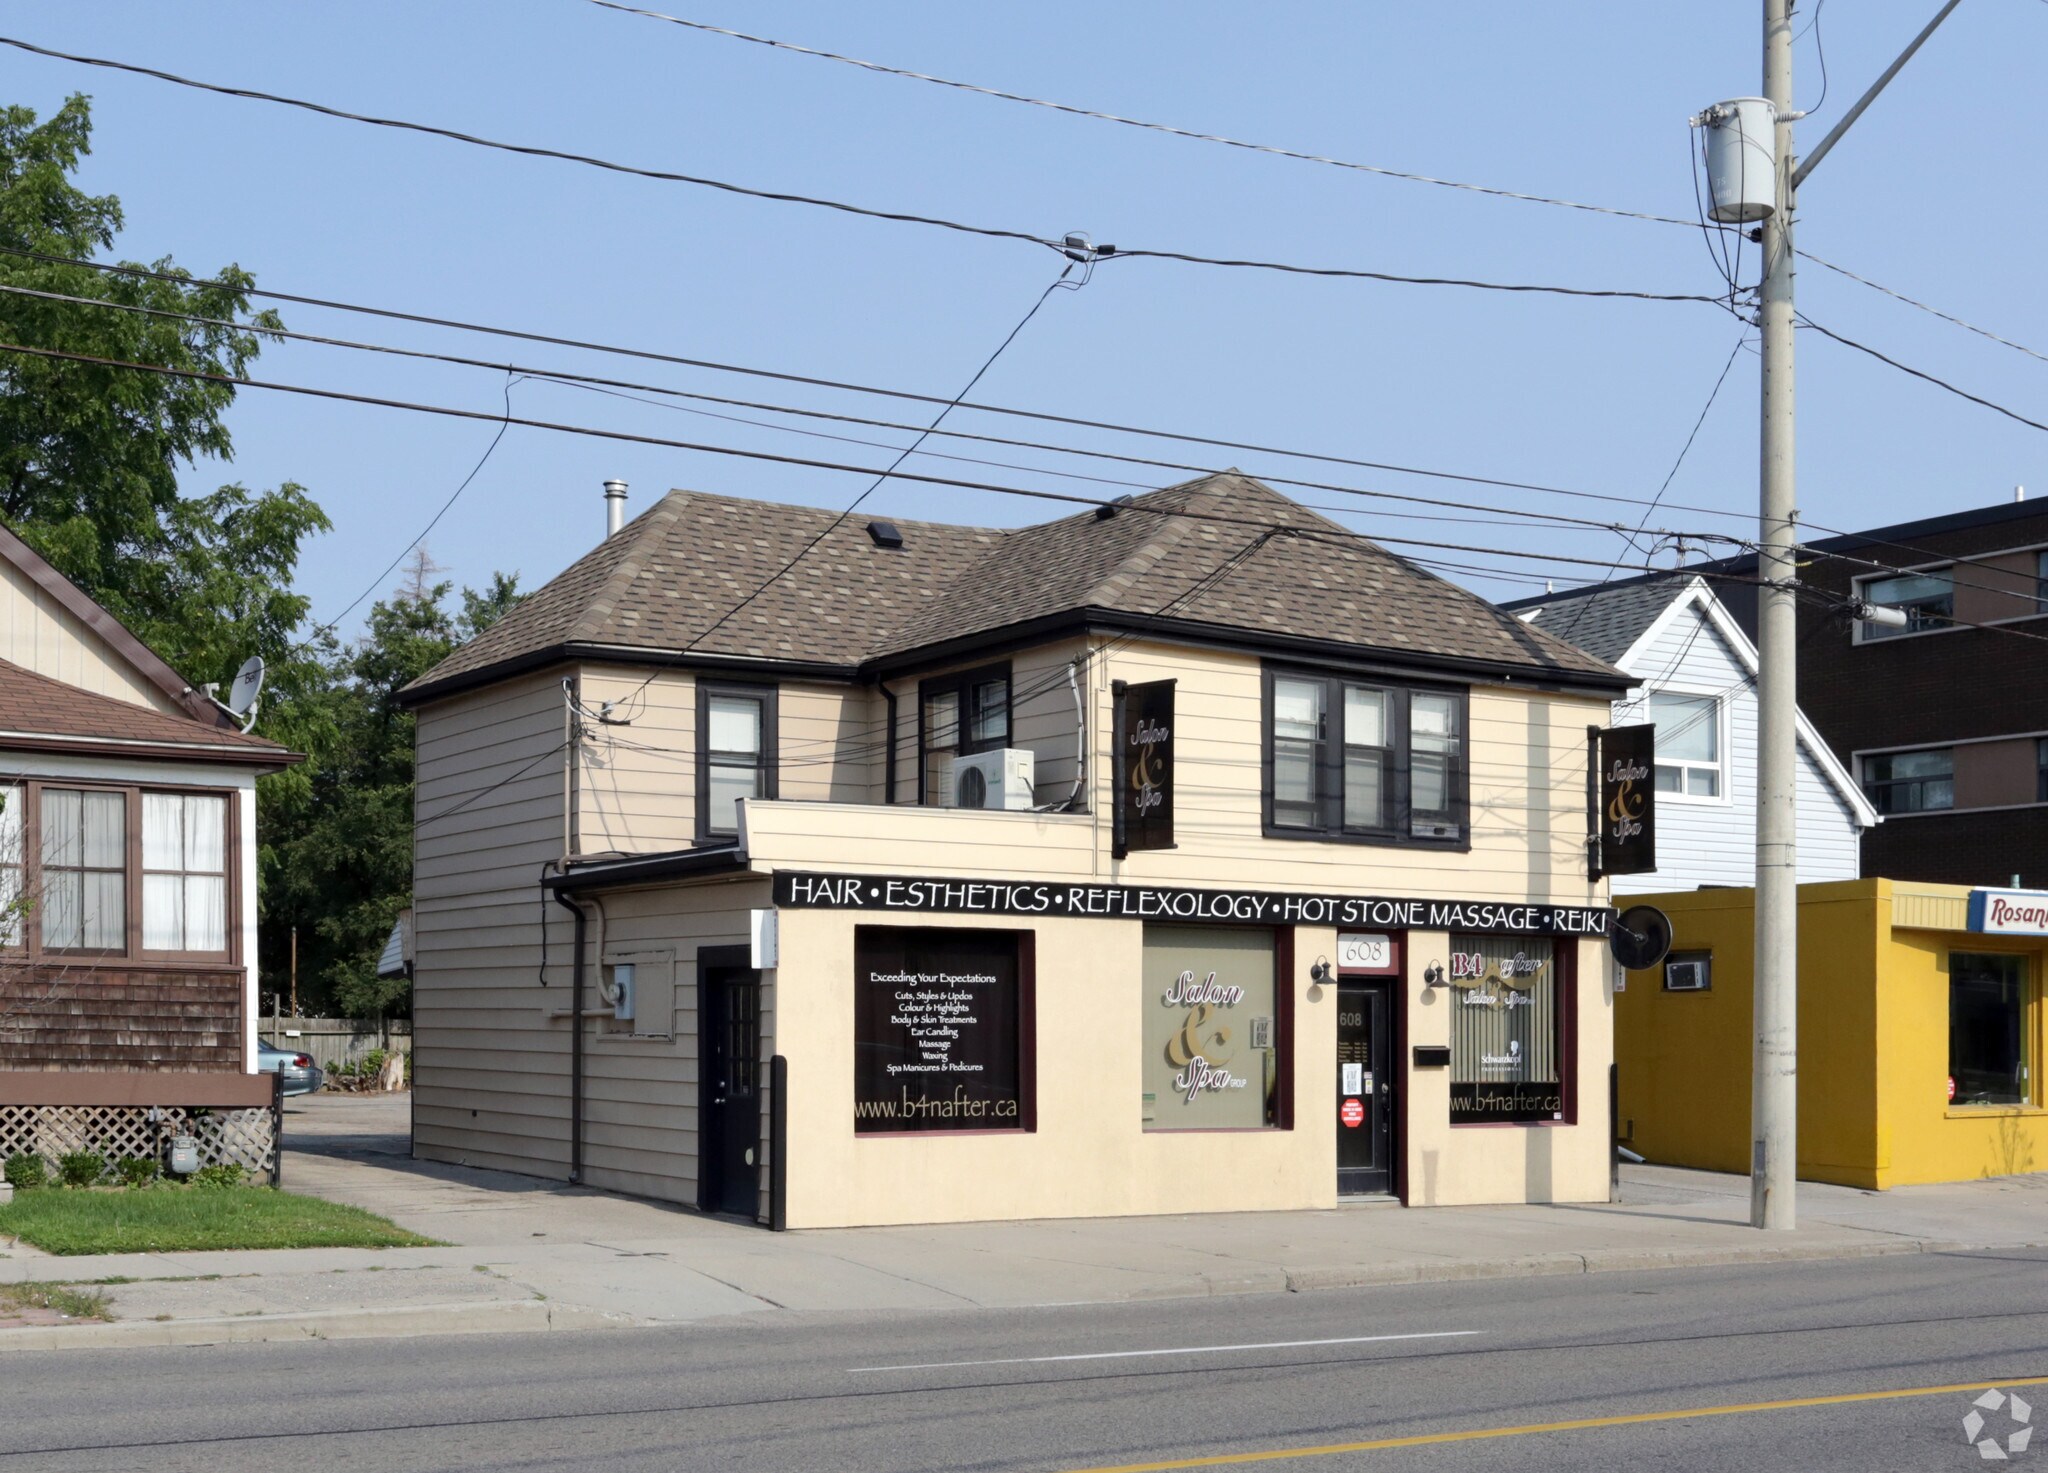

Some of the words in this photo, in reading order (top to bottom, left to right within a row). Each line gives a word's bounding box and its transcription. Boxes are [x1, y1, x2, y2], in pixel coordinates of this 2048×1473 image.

[1130, 718, 1169, 746] Salon
[1132, 742, 1167, 790] &
[1607, 759, 1649, 782] Salon
[1135, 782, 1162, 817] Spa
[1609, 780, 1646, 822] &
[1613, 815, 1642, 845] Spa
[791, 877, 864, 905] HAIR
[885, 880, 1049, 911] ESTHETICS
[1067, 887, 1269, 919] REFLEXOLOGY
[1284, 898, 1341, 922] HOT
[1341, 899, 1425, 925] STONE
[1429, 903, 1540, 930] MASSAGE
[1553, 909, 1607, 933] REIKI
[1991, 898, 2048, 929] Rosan
[1346, 937, 1382, 961] 608
[1452, 952, 1483, 977] B4
[1500, 952, 1543, 979] after
[870, 970, 918, 987] Exceeding
[918, 973, 938, 983] Your
[940, 973, 997, 988] Expectations
[1166, 970, 1245, 1004] Salon
[895, 991, 915, 1002] Cuts,
[916, 990, 939, 1003] Styles
[940, 992, 947, 1000] &
[948, 990, 973, 1004] Updos
[899, 1003, 925, 1012] Colour
[926, 1004, 932, 1012] &
[933, 1002, 970, 1015] Highlights
[1463, 990, 1497, 1005] Salon
[1504, 990, 1528, 1010] Spa
[891, 1016, 912, 1027] Body
[913, 1016, 919, 1024] &
[920, 1014, 937, 1024] Skin
[938, 1015, 977, 1024] Treatments
[1339, 1012, 1362, 1026] 608
[911, 1028, 925, 1036] Ear
[926, 1026, 959, 1039] Candling
[918, 1040, 951, 1050] Massage
[1169, 1003, 1235, 1067] &
[886, 1063, 902, 1076] Spa
[903, 1063, 940, 1072] Manicures
[941, 1064, 948, 1072] &
[949, 1061, 984, 1072] Pedicures
[922, 1051, 948, 1063] Waxing
[1176, 1055, 1231, 1101] Spa
[854, 1084, 1017, 1118] www.b4nafter.ca
